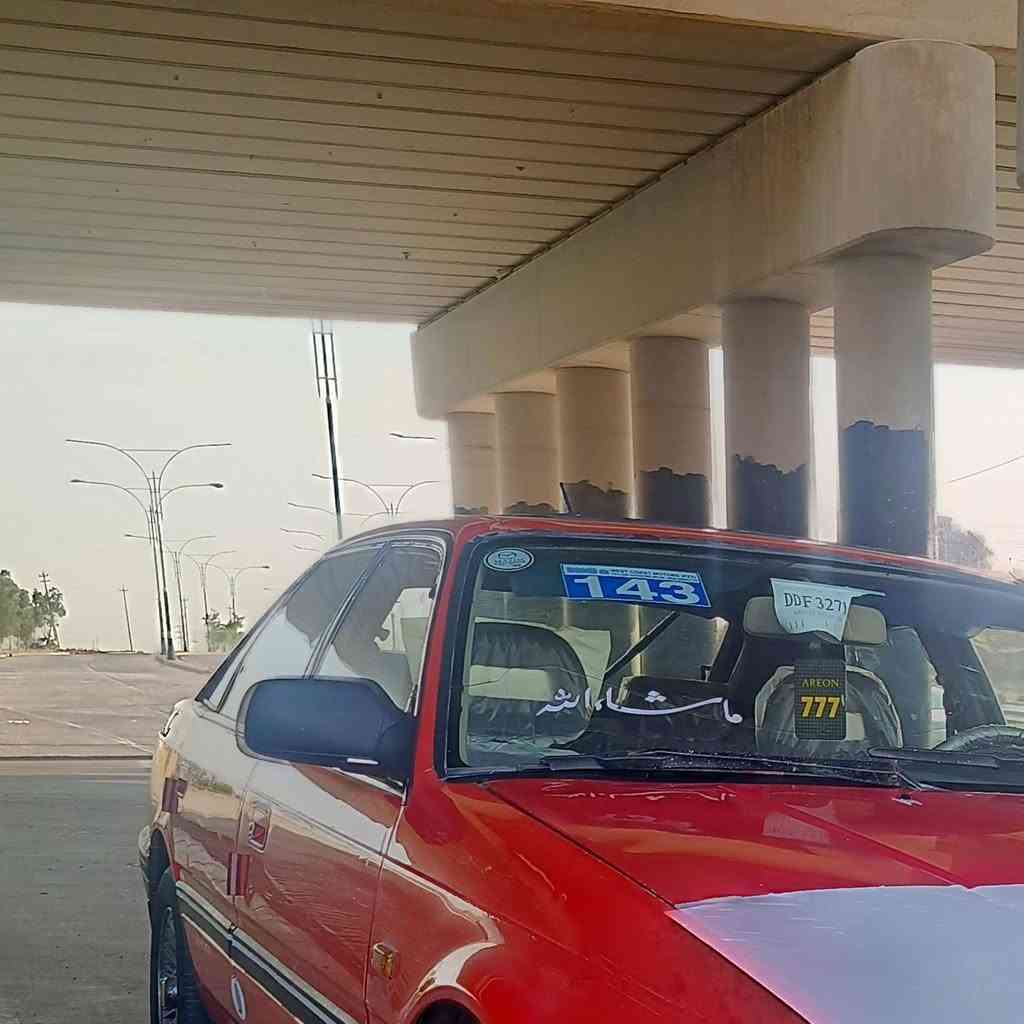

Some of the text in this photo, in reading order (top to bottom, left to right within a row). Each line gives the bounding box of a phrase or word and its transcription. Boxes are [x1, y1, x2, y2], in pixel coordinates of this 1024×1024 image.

[574, 574, 701, 605] 143
[801, 678, 840, 689] AREON
[800, 695, 841, 719] 777
